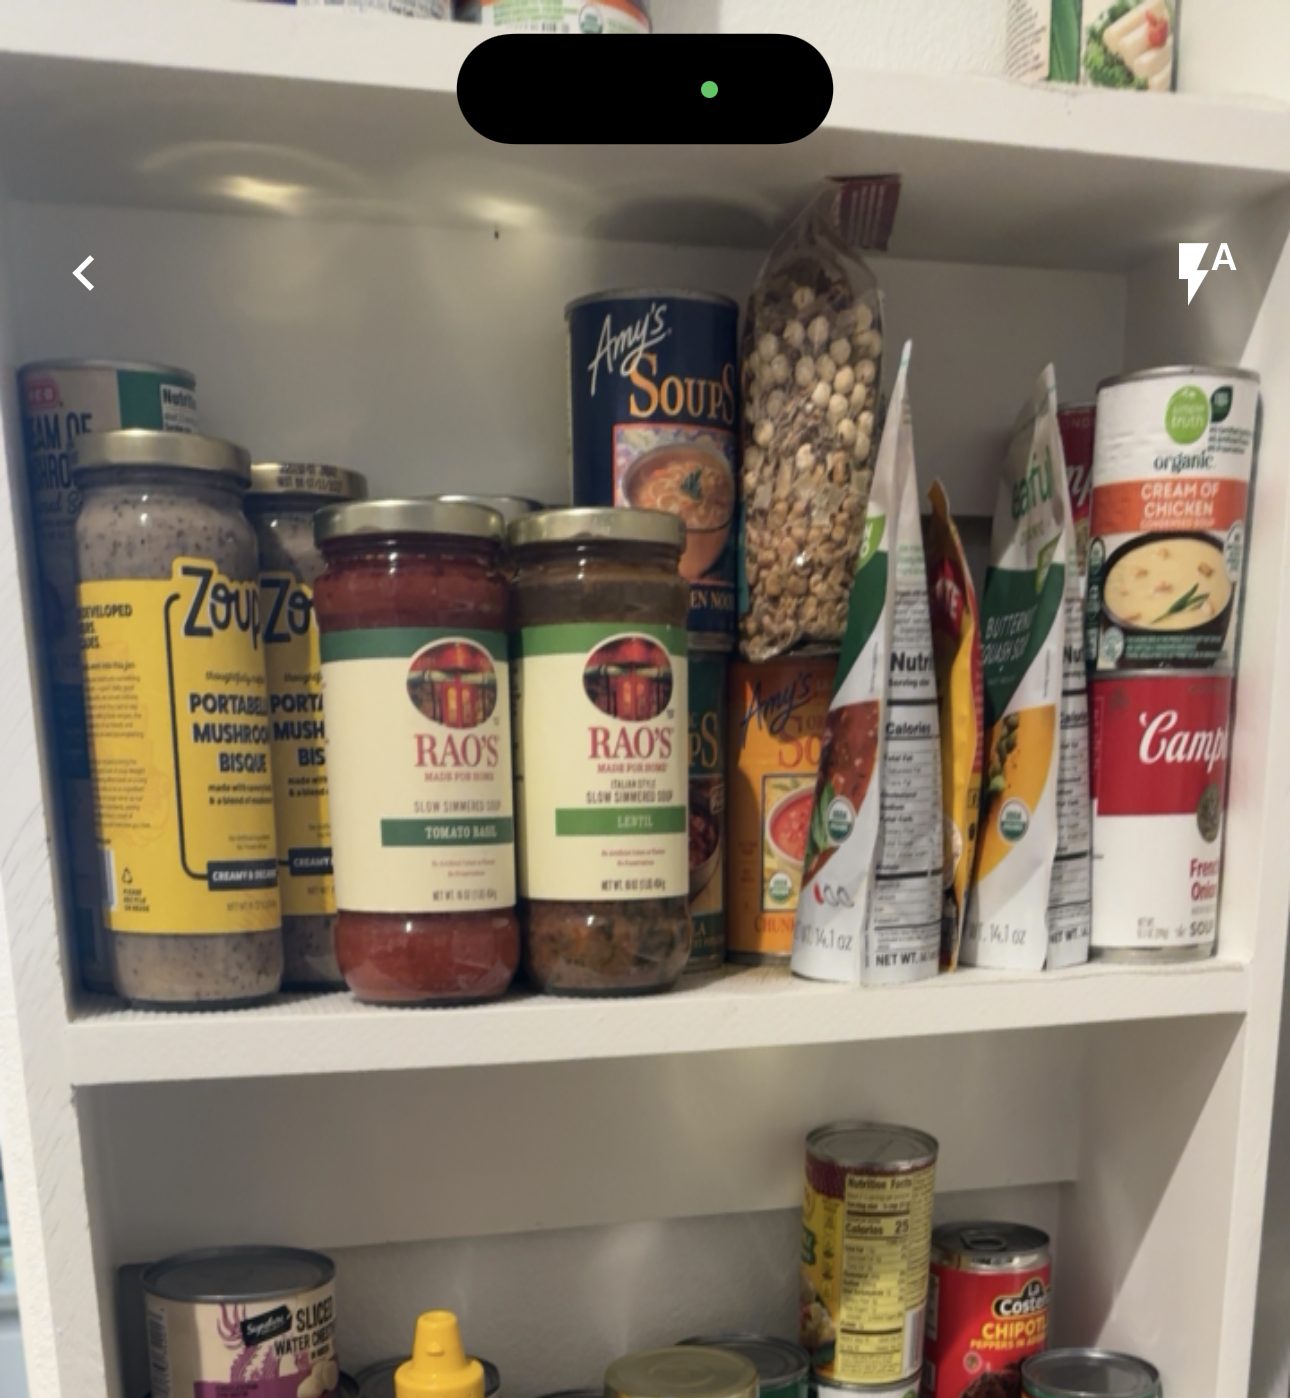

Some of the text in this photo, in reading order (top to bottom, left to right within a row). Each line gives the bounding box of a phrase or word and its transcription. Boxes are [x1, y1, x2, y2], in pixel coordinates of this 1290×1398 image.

[588, 302, 669, 396] Amy's
[1153, 450, 1215, 473] organic
[1141, 482, 1220, 500] CREAM OF
[1144, 500, 1213, 519] CHICKEN
[414, 733, 499, 768] RAO'S
[588, 726, 673, 759] RAO'S
[219, 751, 267, 773] BISQUE
[597, 763, 624, 774] MADE
[586, 790, 612, 804] SLOW
[413, 800, 441, 814] SLOW
[617, 814, 654, 829] LENTIL
[424, 824, 497, 840] TOMATO BASIL
[212, 869, 248, 883] CREAMY
[875, 953, 897, 967] NET
[847, 1177, 887, 1191] Nutrition
[845, 1222, 884, 1237] Calories
[894, 1219, 909, 1235] 25
[274, 1334, 310, 1357] WATER
